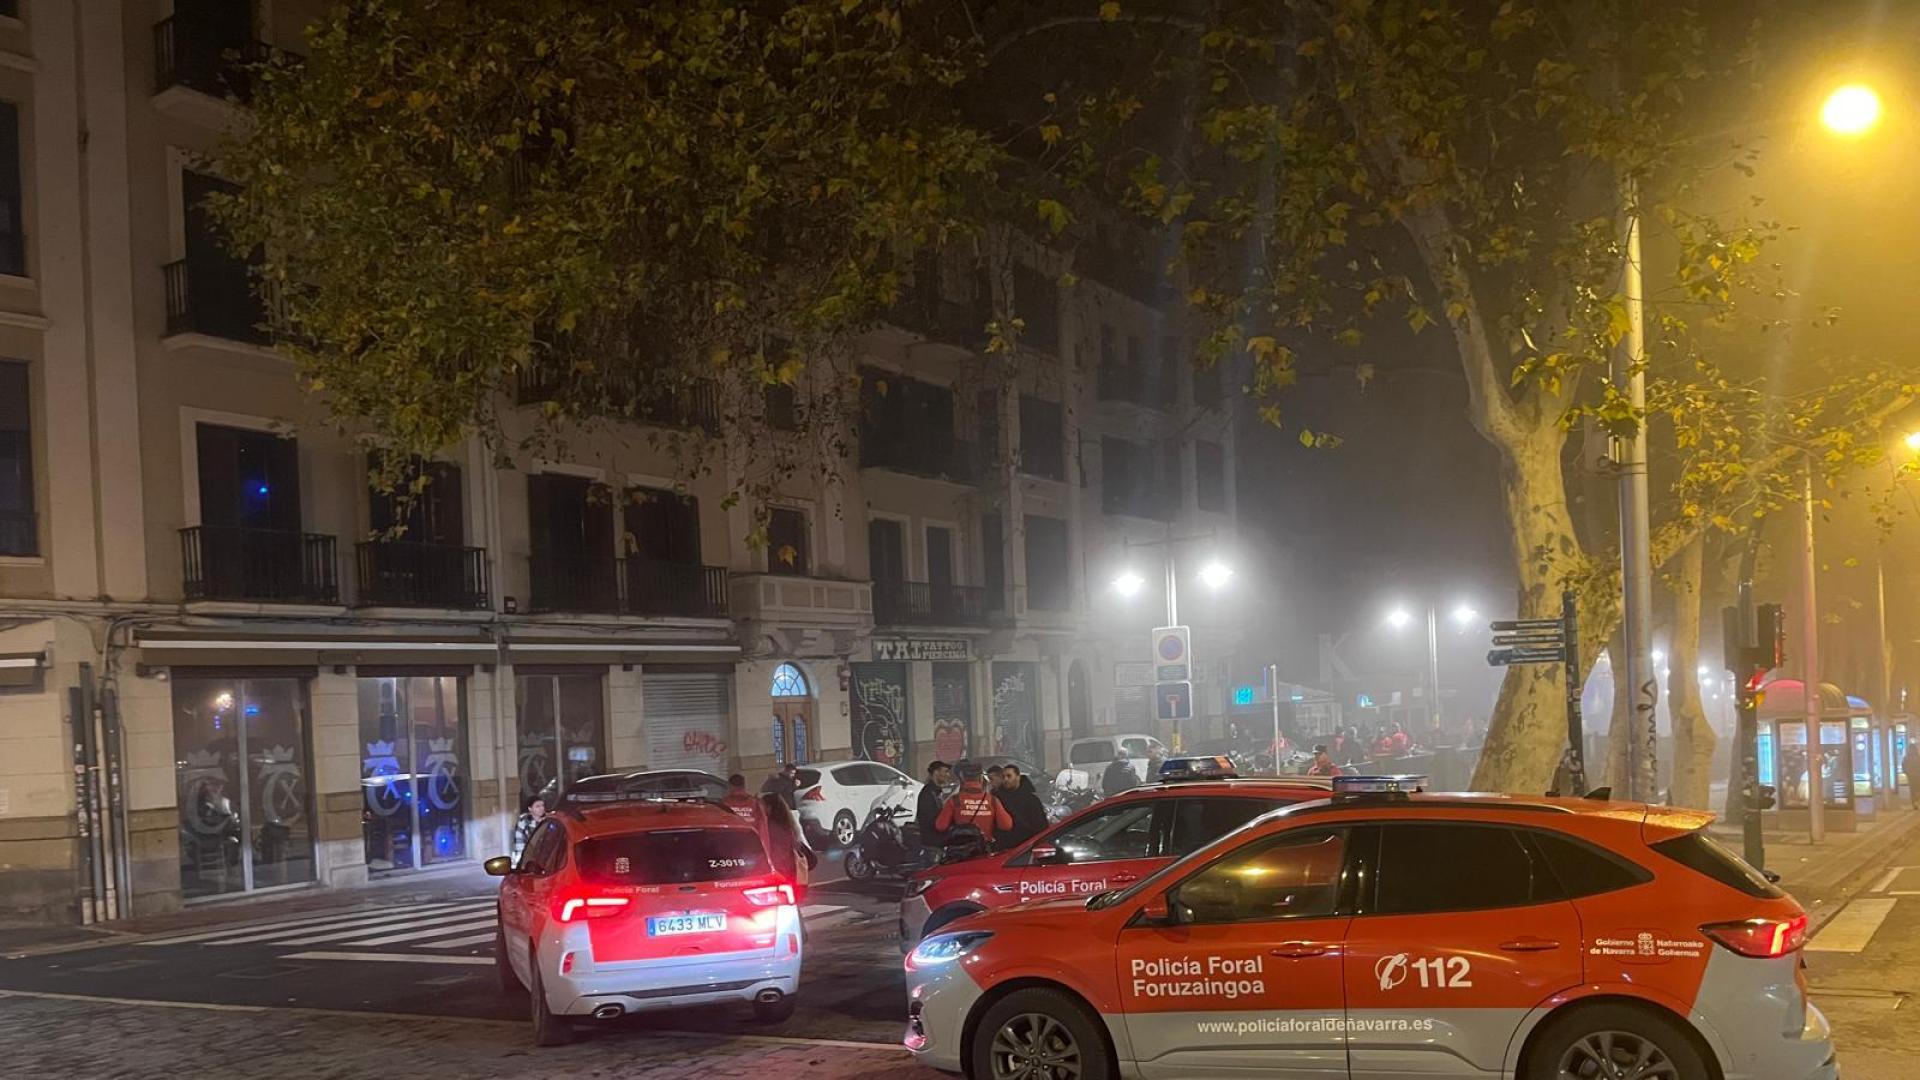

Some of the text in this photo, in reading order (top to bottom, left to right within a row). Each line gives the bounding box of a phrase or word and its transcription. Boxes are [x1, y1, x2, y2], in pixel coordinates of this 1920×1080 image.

[708, 859, 746, 869] Z-3019
[635, 886, 660, 894] Foral
[1020, 878, 1108, 895] Policía Foral
[658, 915, 724, 933] 6433 MLV
[1590, 946, 1636, 956] de Navarra
[1595, 938, 1635, 947] Gobierno
[1131, 955, 1263, 977] Policía Foral
[1410, 956, 1473, 988] 112
[1133, 978, 1265, 999] Foruzaingoa
[1197, 1016, 1433, 1036] www.policiaforaldenavarra.es
